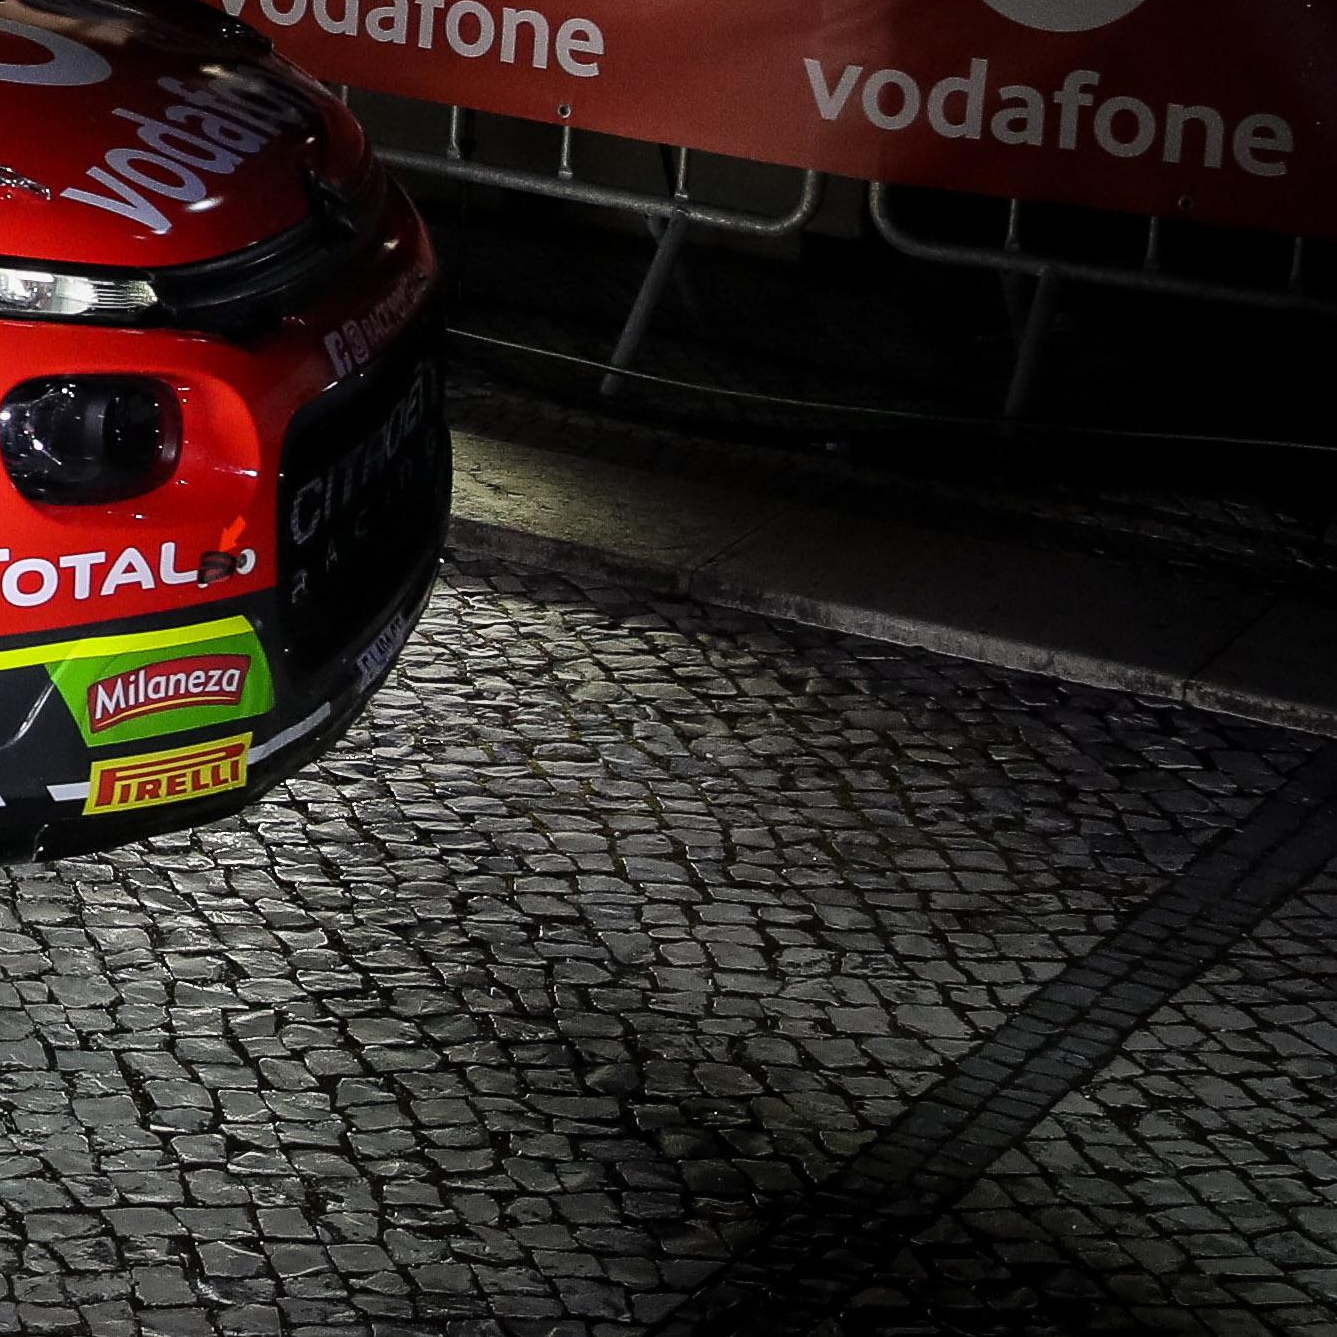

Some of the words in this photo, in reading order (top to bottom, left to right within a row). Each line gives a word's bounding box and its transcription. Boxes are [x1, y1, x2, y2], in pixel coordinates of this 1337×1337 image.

[803, 56, 1295, 179] vodafone
[94, 668, 242, 720] Milaneza
[94, 742, 248, 807] PIRELLI
